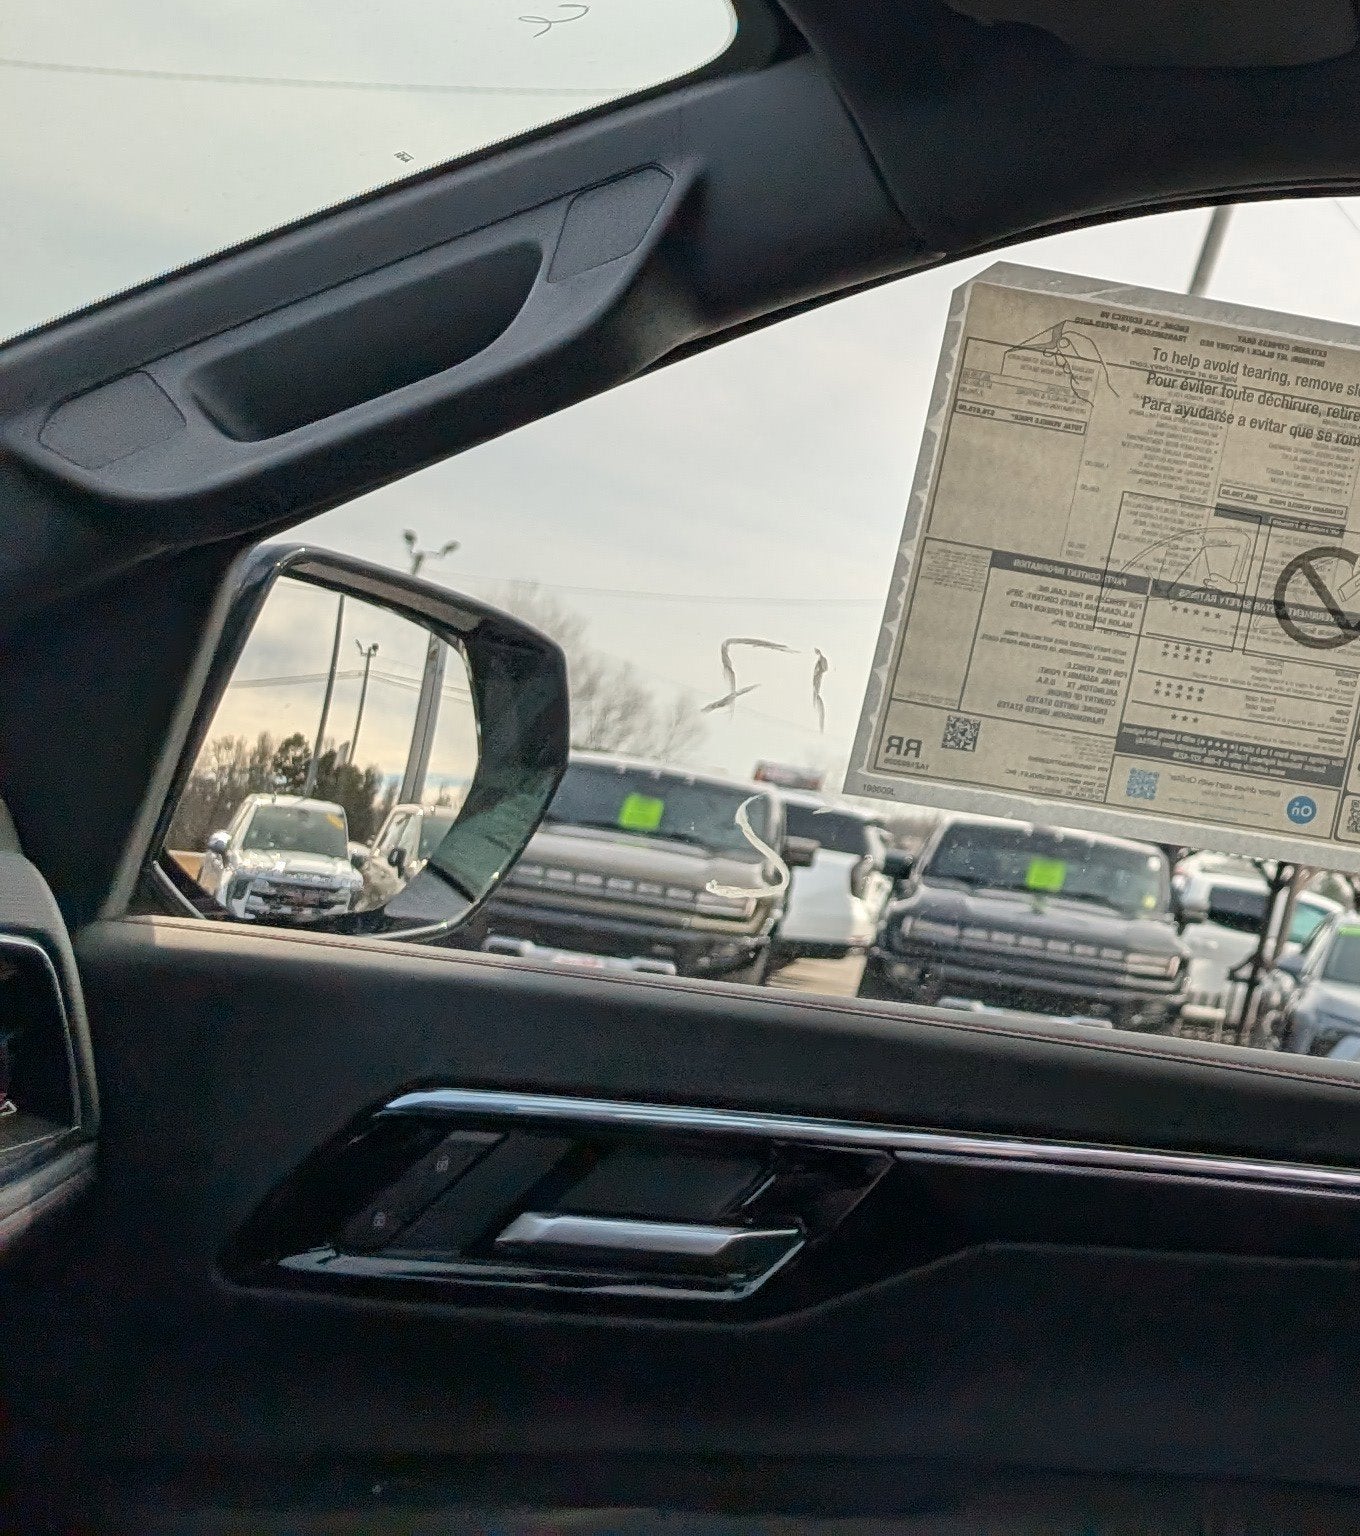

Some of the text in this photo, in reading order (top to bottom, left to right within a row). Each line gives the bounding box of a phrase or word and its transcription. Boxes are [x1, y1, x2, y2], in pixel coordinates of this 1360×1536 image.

[1150, 346, 1169, 362] To
[1170, 350, 1200, 369] help
[1202, 356, 1239, 374] avoid
[1239, 363, 1292, 387] tearing,
[1294, 375, 1343, 393] remove
[1145, 372, 1177, 389] Pour
[1178, 376, 1217, 395] éviter
[1219, 384, 1255, 402] toute
[1256, 390, 1324, 417] déchirure,
[1139, 396, 1172, 413] Para
[1173, 403, 1234, 426] ayudarse
[1237, 415, 1246, 426] a
[1248, 416, 1287, 434] evitar
[1287, 424, 1314, 441] que
[1315, 429, 1332, 442] se
